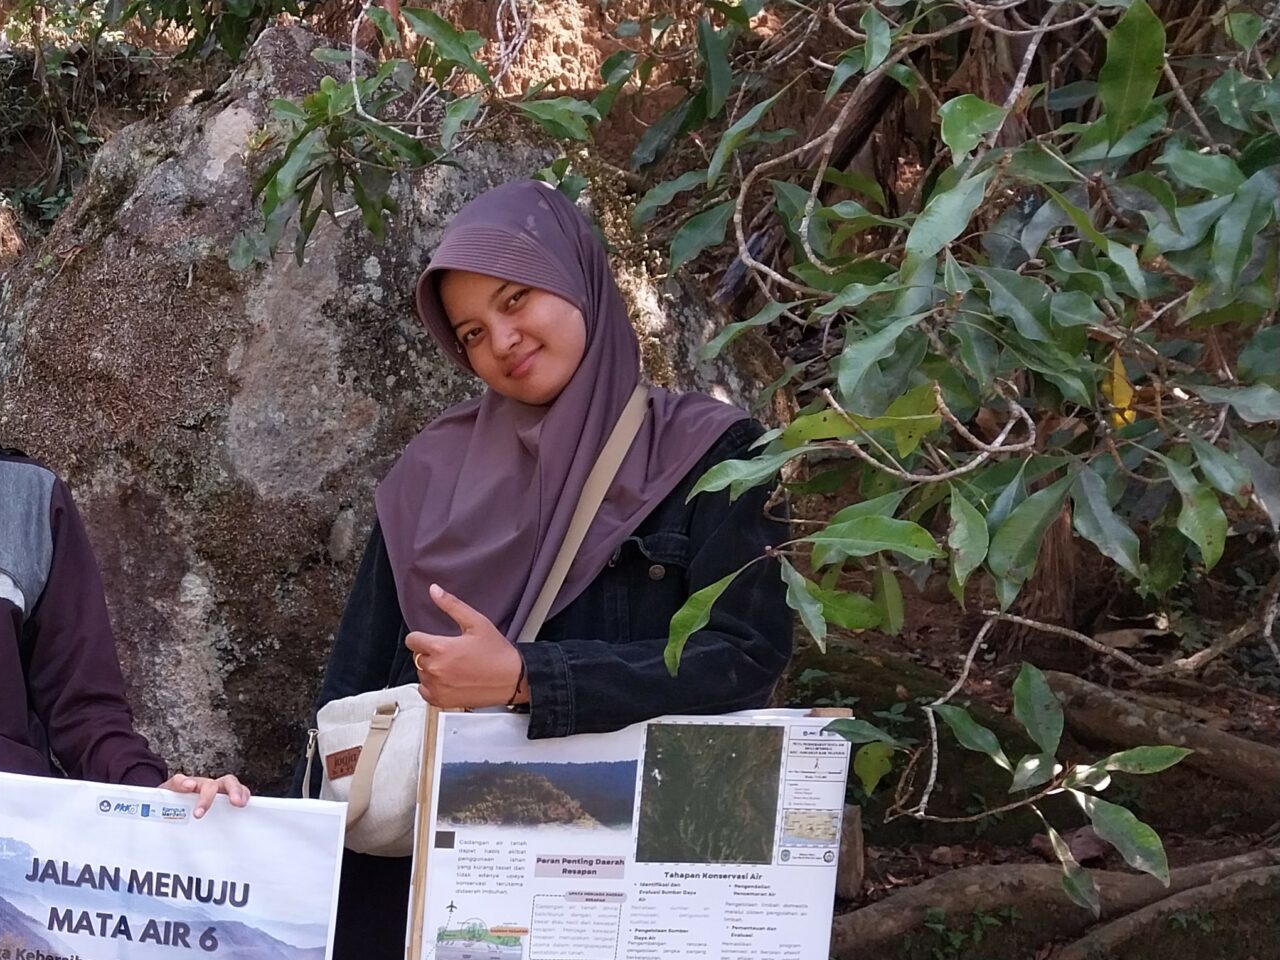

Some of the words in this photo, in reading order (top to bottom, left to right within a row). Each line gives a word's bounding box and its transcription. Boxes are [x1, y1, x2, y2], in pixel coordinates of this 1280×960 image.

[562, 858, 593, 866] Penting
[562, 868, 597, 876] Resapan
[26, 858, 120, 891] JALAN
[127, 870, 250, 908] MENUJU
[48, 907, 132, 941] MATA
[139, 919, 192, 948] AIR
[198, 926, 218, 951] 6
